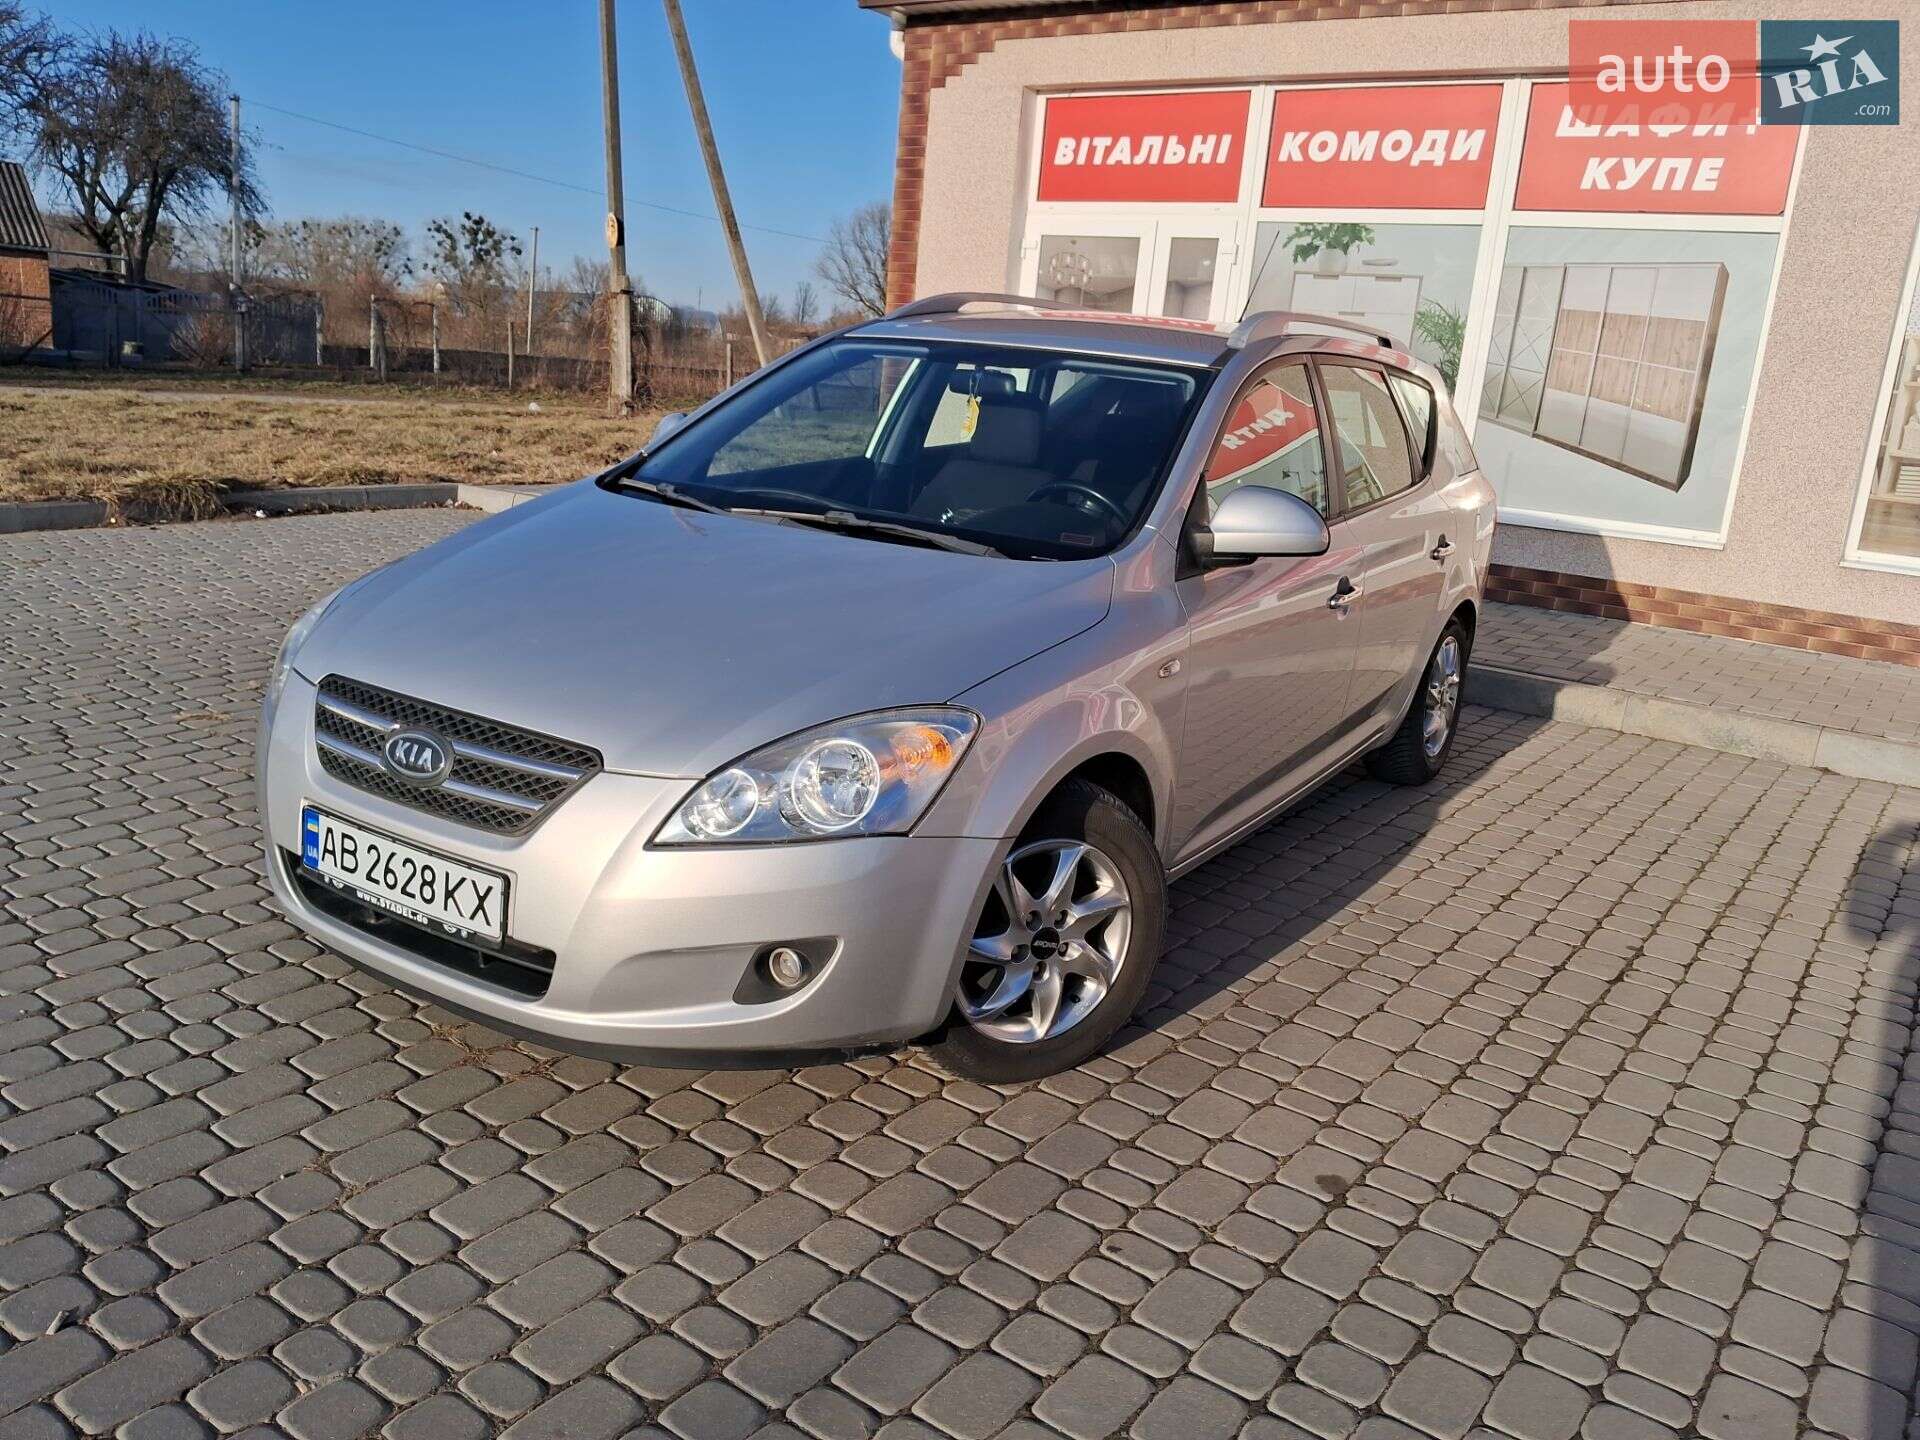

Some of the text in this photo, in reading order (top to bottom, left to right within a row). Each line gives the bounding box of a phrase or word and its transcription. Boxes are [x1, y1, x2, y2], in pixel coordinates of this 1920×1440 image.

[1053, 134, 1232, 166] ВІТАЛЬНІ
[1277, 129, 1486, 167] КОМОДИ
[1580, 157, 1725, 191] КУПЕ
[396, 741, 433, 772] KIA
[307, 845, 319, 858] UA
